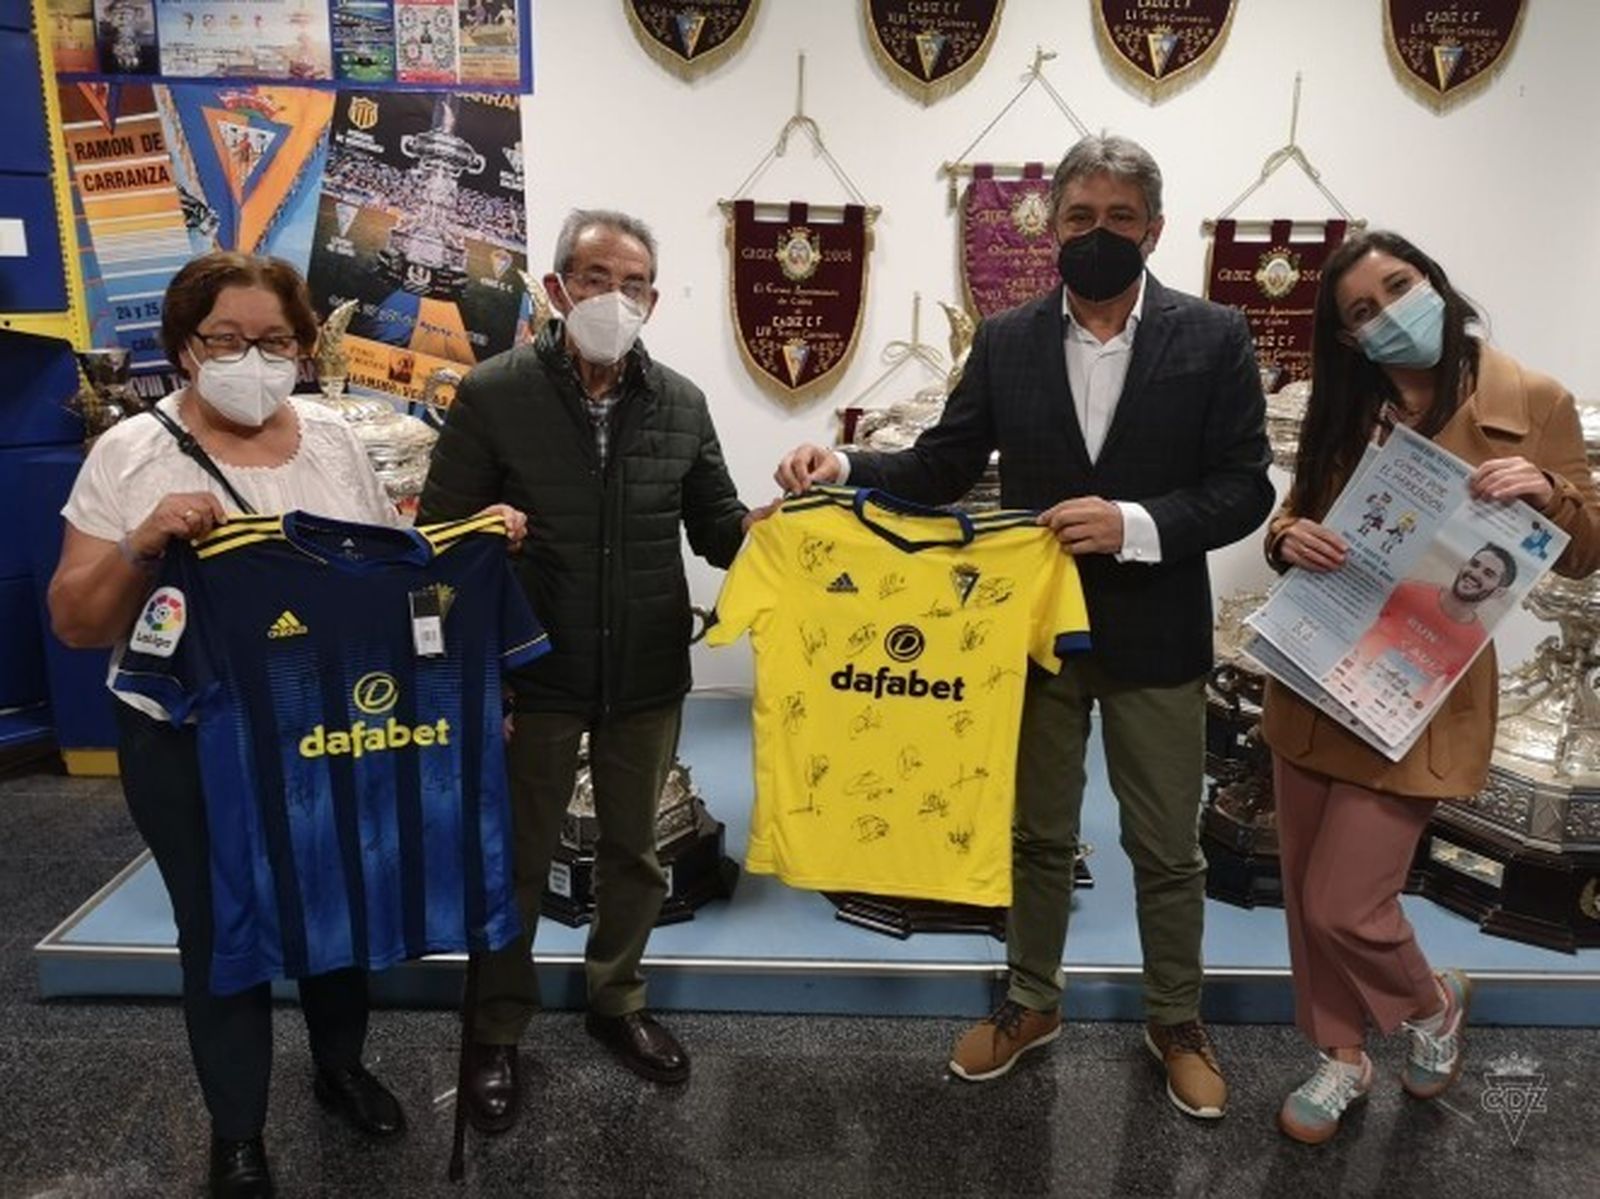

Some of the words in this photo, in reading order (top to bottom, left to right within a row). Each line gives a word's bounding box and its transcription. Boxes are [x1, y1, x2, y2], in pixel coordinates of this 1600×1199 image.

[74, 136, 135, 160] RAMON
[141, 132, 164, 153] DE
[83, 165, 171, 191] CARRANZA
[831, 663, 966, 702] dafabet
[300, 717, 450, 759] dafabet
